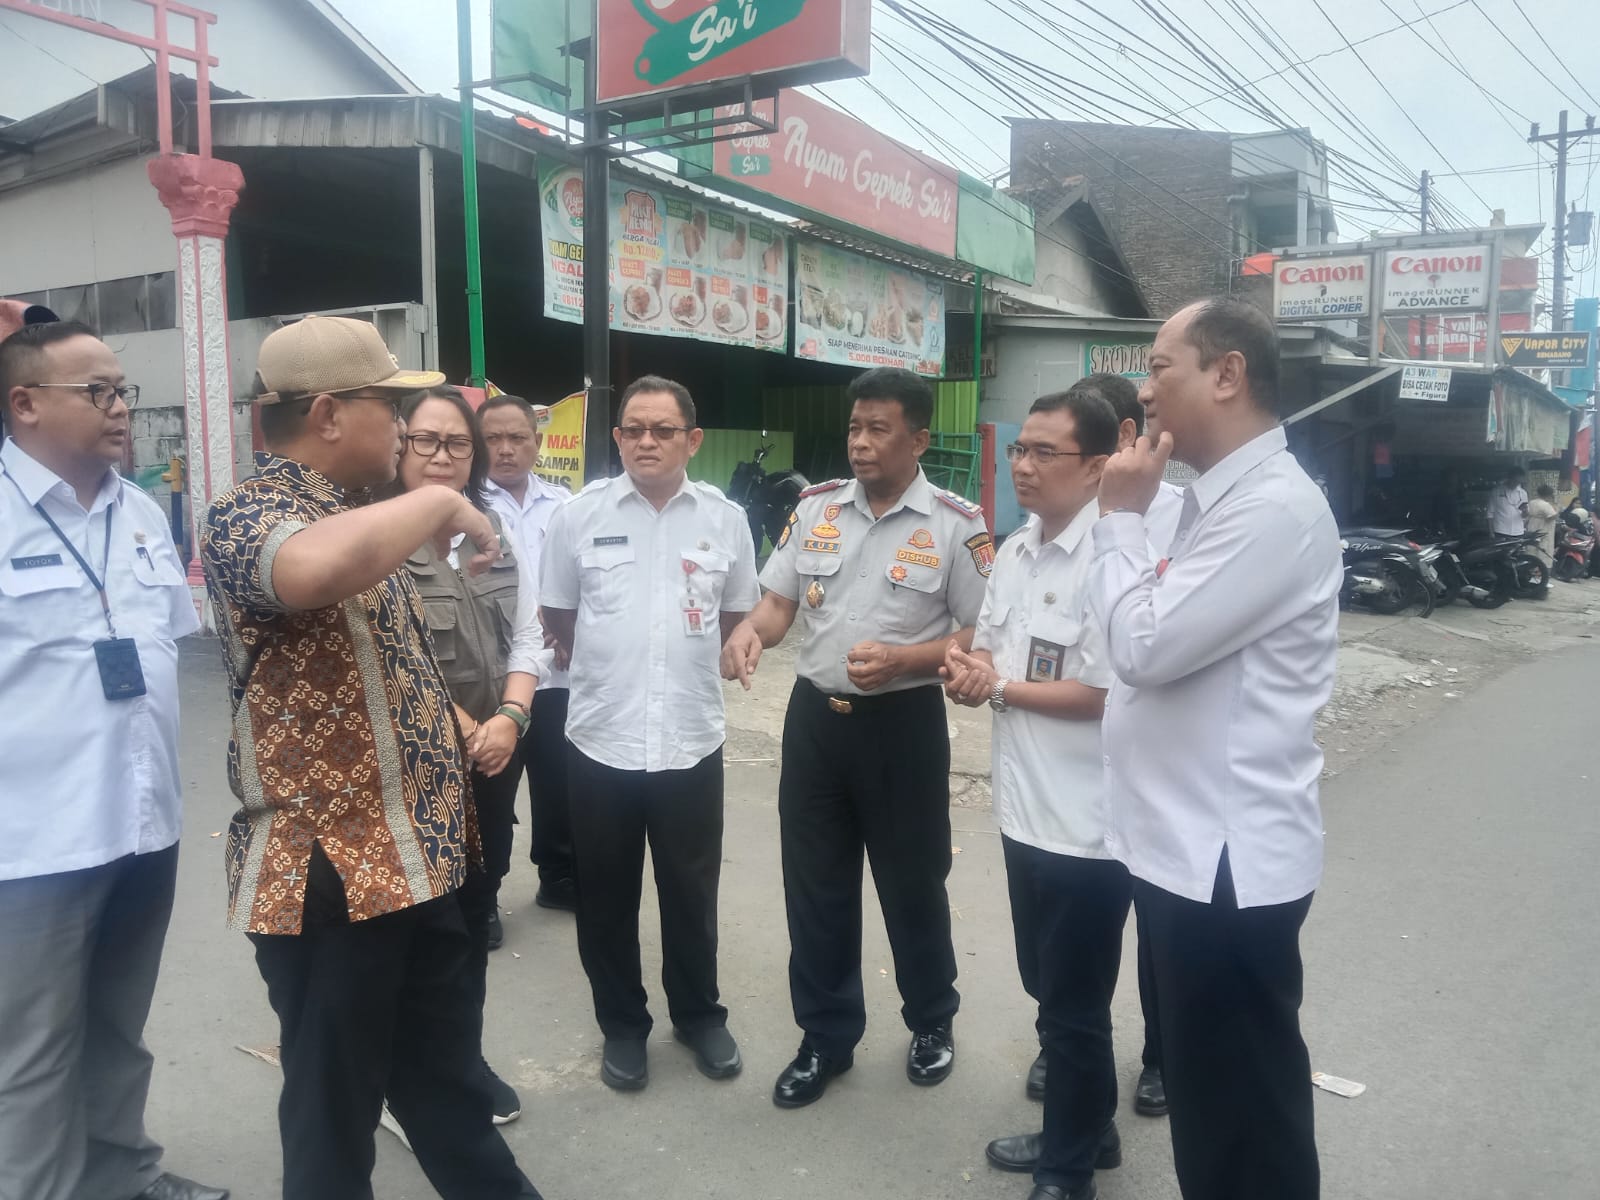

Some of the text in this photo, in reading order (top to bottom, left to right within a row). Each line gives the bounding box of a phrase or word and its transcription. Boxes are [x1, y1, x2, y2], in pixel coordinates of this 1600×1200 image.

[688, 0, 757, 61] Sa'i
[784, 116, 951, 223] Ayam Geprek Sa'i
[1391, 254, 1483, 274] Canon
[1279, 264, 1364, 285] Canon
[1388, 286, 1481, 298] imageRUNNER
[1279, 295, 1363, 306] imageRUNNER
[1397, 295, 1470, 308] ADVANCE
[1279, 302, 1362, 316] DIGITAL COPIER
[827, 338, 842, 348] SIAP
[843, 341, 874, 353] MENERIMA
[1562, 336, 1587, 350] CITY
[1089, 345, 1153, 374] SAUDAR
[1401, 379, 1449, 392] BISA CETAK FOTO
[806, 540, 836, 551] KUS
[897, 551, 939, 567] DISHUB
